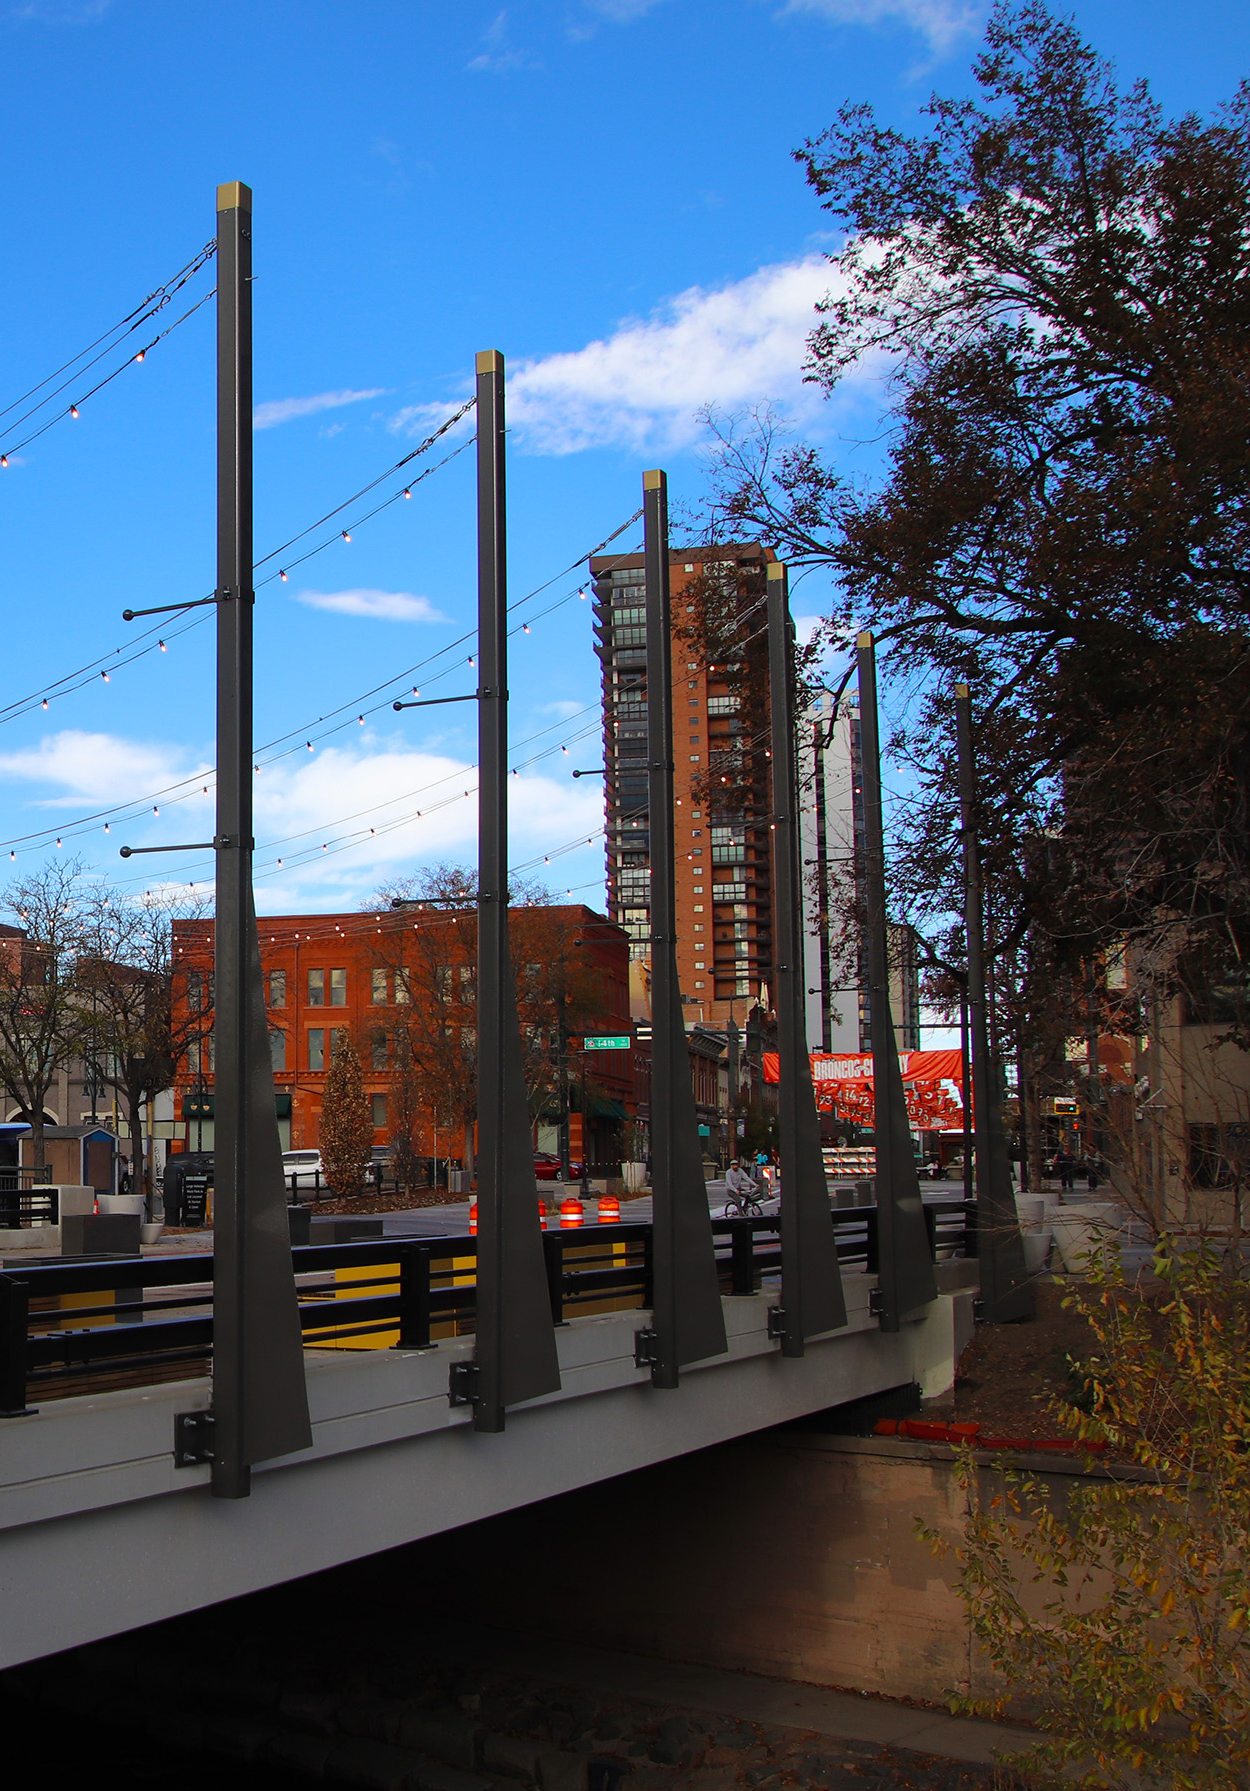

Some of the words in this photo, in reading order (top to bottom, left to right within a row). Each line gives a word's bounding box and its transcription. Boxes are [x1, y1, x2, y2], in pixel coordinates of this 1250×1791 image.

[814, 1059, 861, 1081] BRONCOS
[819, 1095, 832, 1106] 93
[845, 1089, 857, 1101] 14
